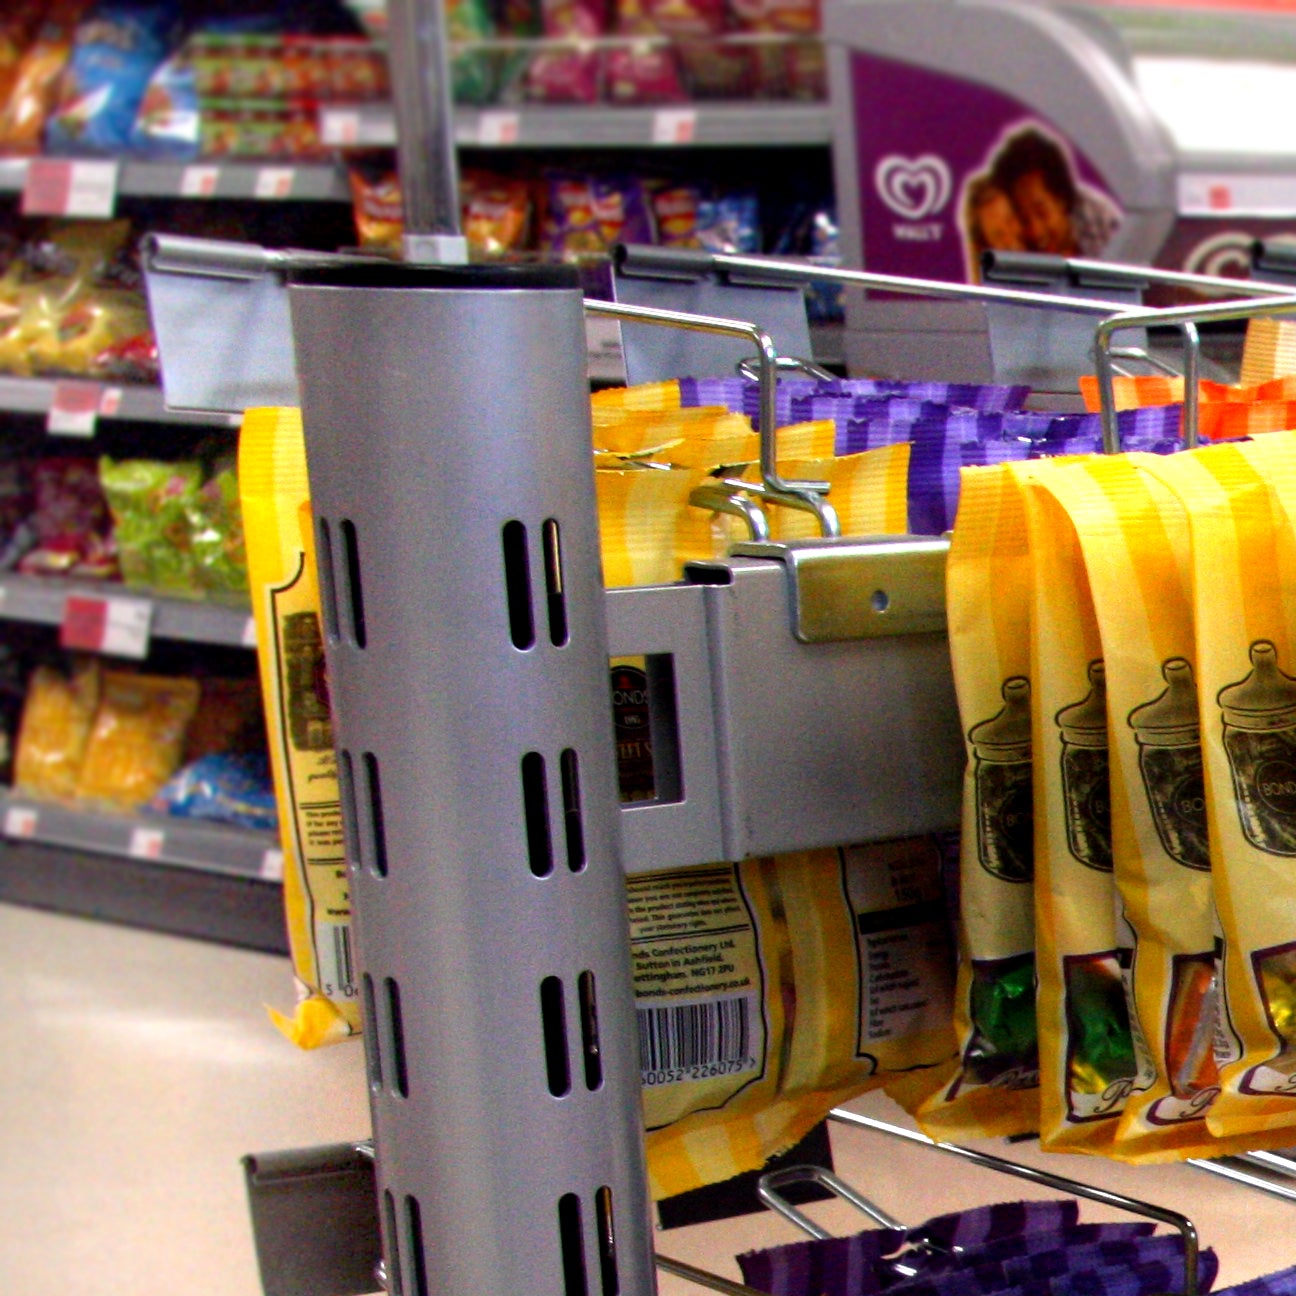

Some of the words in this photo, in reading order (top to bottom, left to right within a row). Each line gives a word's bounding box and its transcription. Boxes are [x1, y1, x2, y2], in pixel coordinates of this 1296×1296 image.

[652, 943, 717, 957] Confectionery
[636, 960, 669, 971] Sutton
[691, 1060, 743, 1080] 226075
